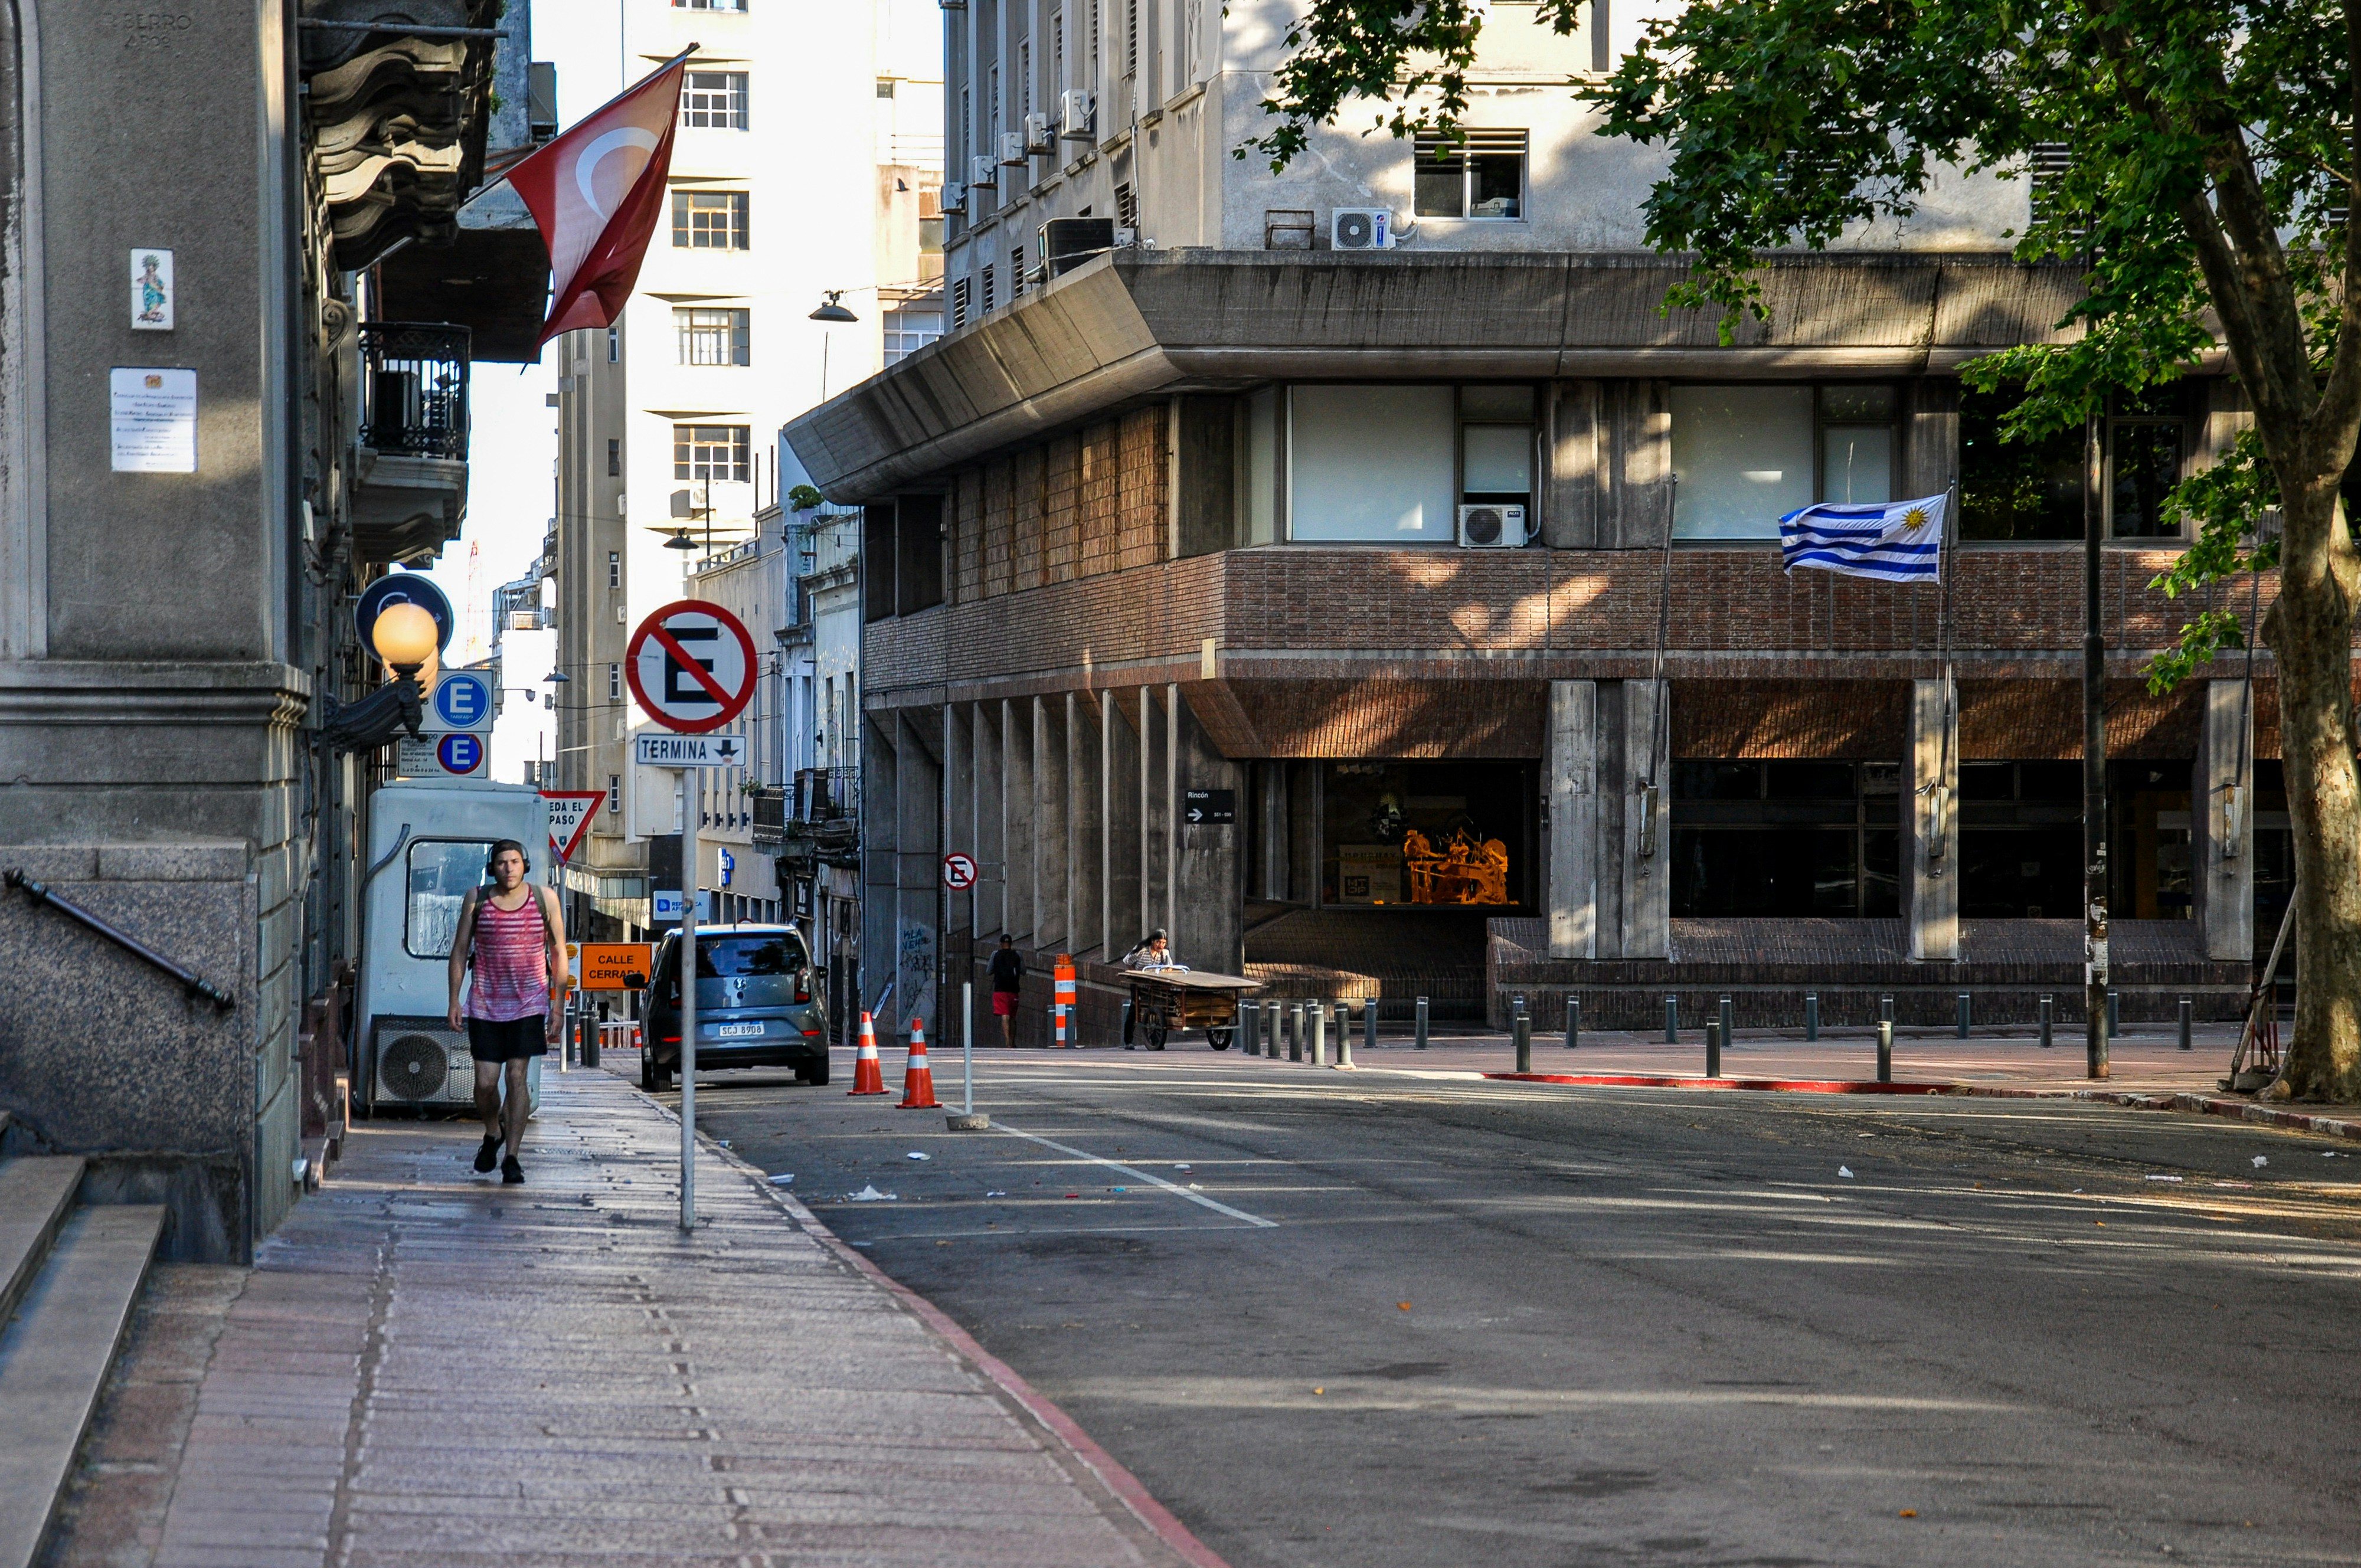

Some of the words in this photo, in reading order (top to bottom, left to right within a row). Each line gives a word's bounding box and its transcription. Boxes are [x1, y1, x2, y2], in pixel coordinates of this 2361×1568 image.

[665, 627, 720, 703] E
[450, 683, 473, 713] E
[452, 739, 470, 765] E
[642, 740, 707, 760] TERMINA
[550, 802, 567, 811] EDA
[573, 802, 583, 811] EL
[550, 815, 574, 824] PASO
[950, 860, 967, 882] E
[598, 955, 634, 964] CALLE
[722, 1026, 738, 1035] SCJ
[741, 1025, 761, 1034] 8908
